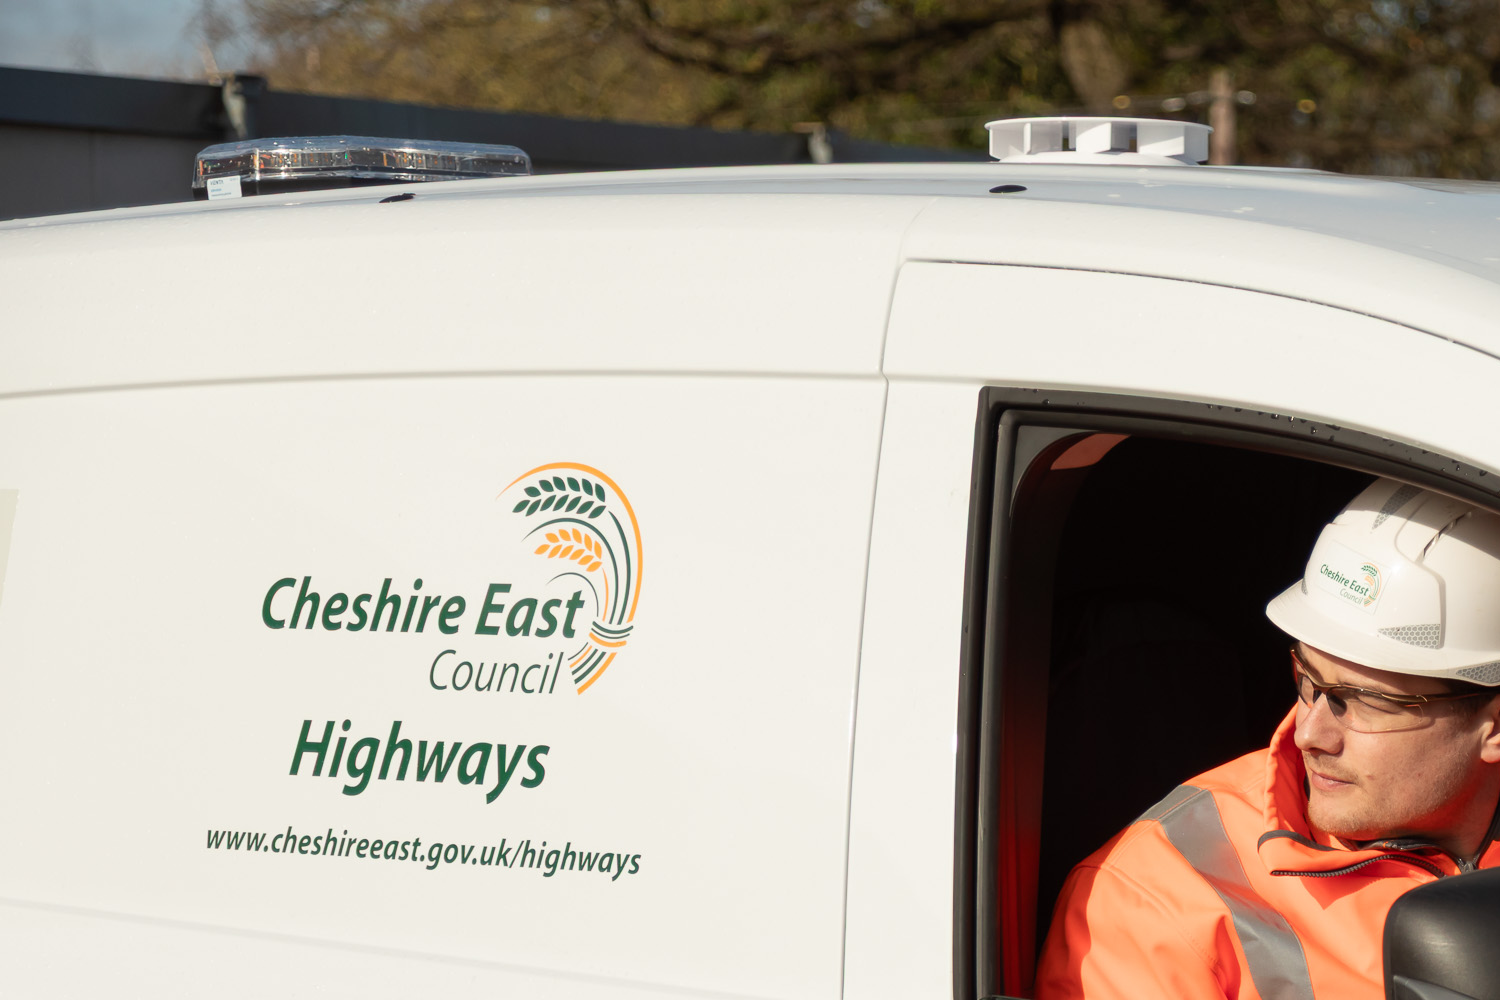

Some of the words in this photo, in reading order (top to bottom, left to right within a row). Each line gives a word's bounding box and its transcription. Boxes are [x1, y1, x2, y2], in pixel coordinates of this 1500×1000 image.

[1320, 563, 1350, 587] Cheshire
[1349, 579, 1370, 597] East
[1339, 588, 1364, 605] Council
[262, 576, 466, 634] Cheshire
[475, 583, 586, 638] East
[429, 649, 565, 694] Council
[289, 719, 550, 805] Highways
[206, 826, 642, 882] www.cheshireeast.gov.uk/highways
